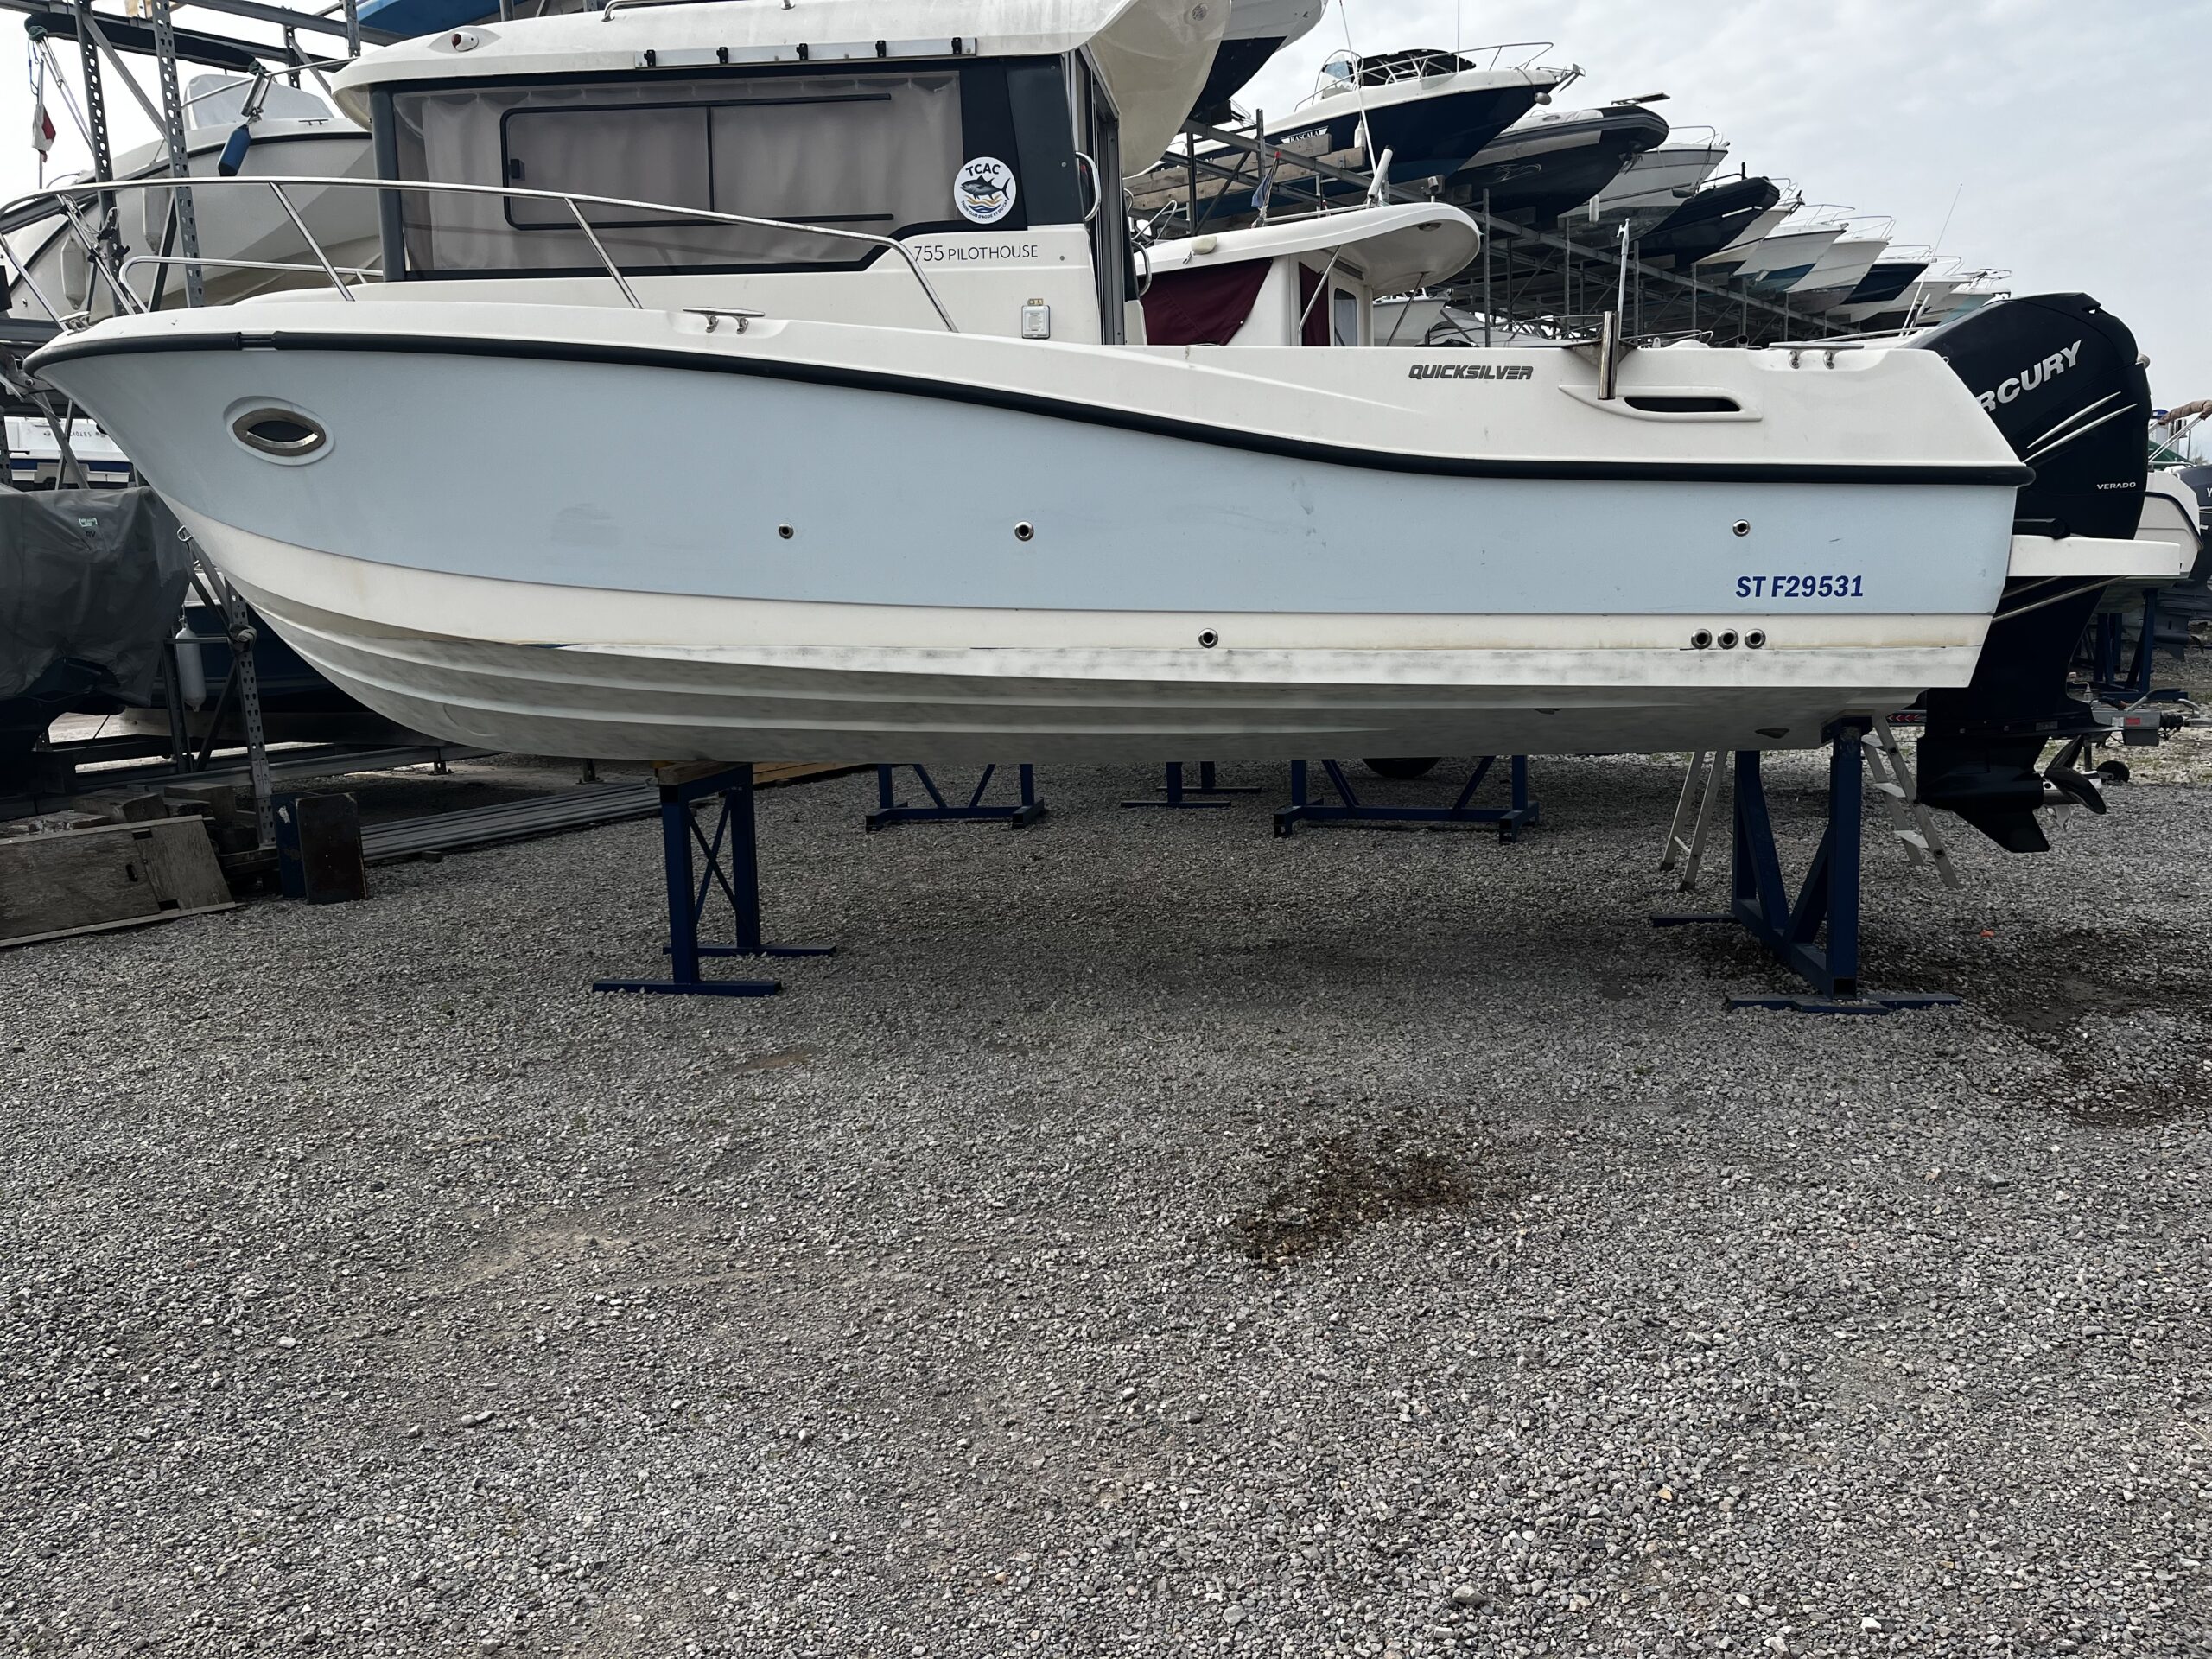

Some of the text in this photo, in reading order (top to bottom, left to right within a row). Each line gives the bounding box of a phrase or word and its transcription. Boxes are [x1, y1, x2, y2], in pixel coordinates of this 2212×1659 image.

[965, 162, 1001, 177] TCAC
[914, 245, 1038, 262] 755 PILOTHOUSE
[1408, 364, 1534, 380] QUICKSILVER
[1975, 340, 2082, 412] RCURY
[2096, 481, 2137, 490] VERADO
[1735, 575, 1864, 598] ST F29531
